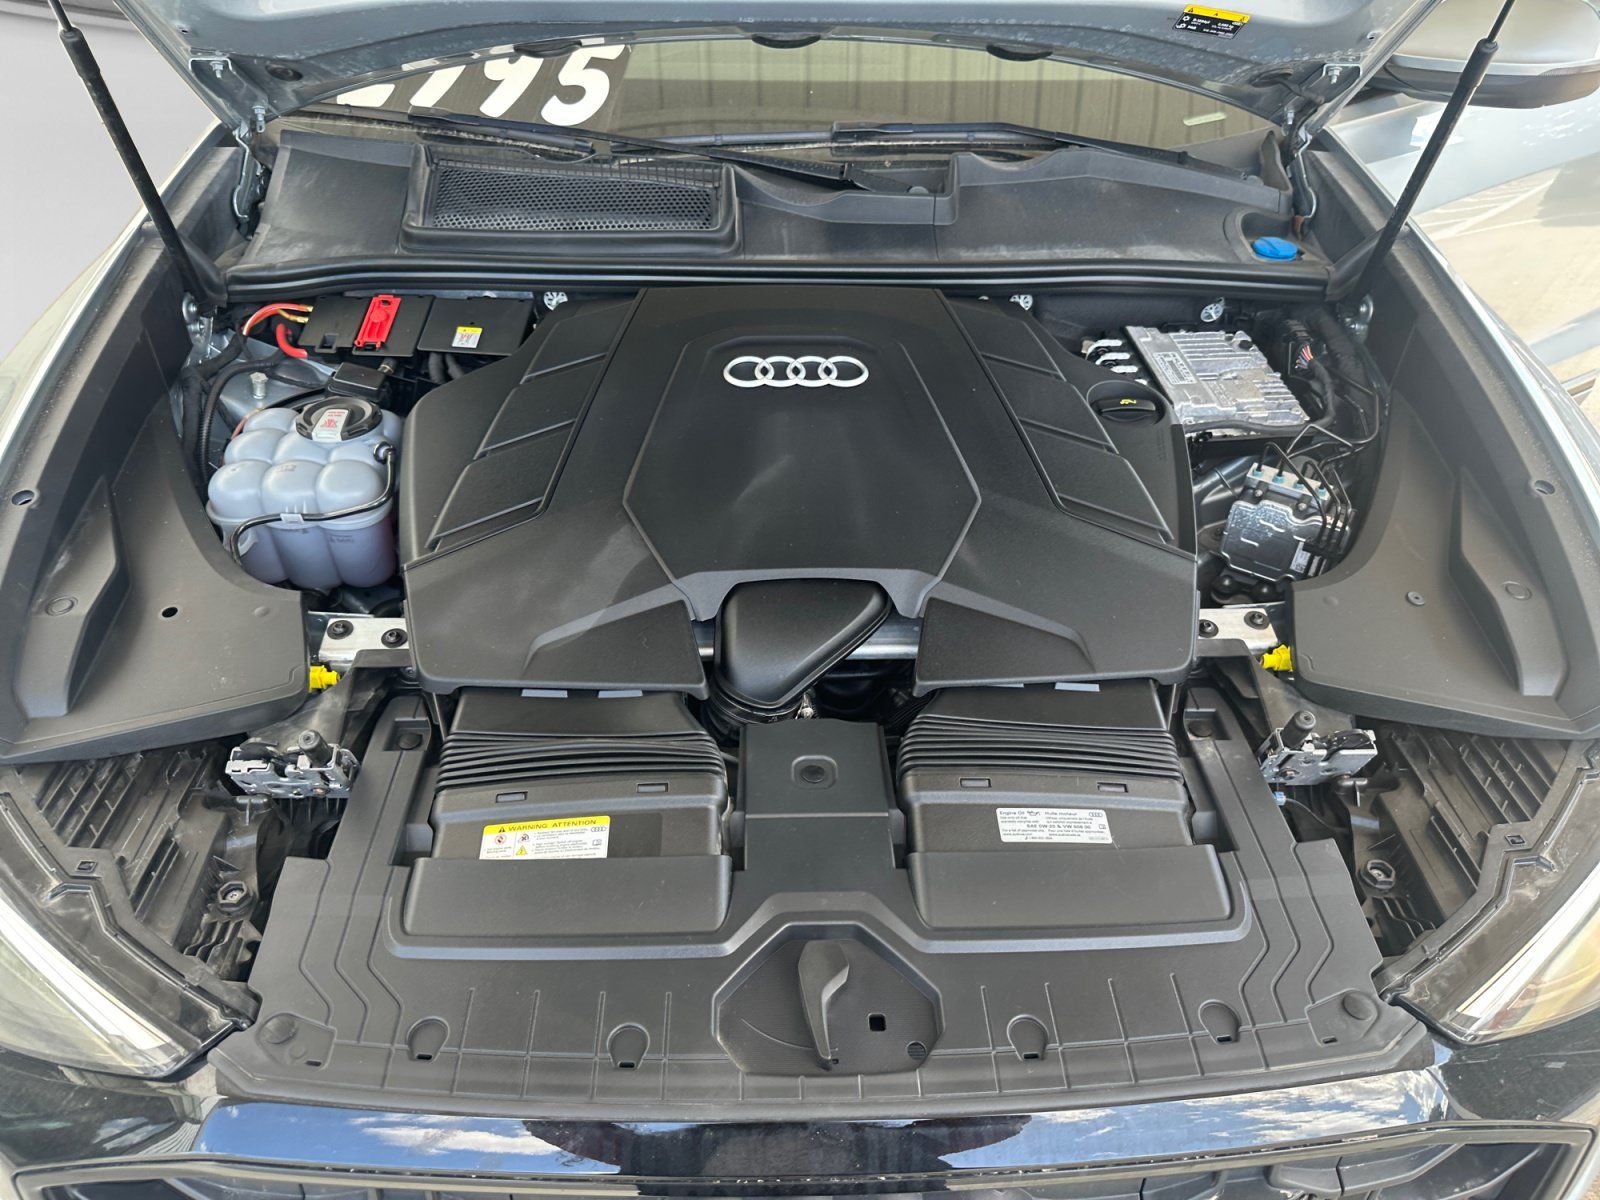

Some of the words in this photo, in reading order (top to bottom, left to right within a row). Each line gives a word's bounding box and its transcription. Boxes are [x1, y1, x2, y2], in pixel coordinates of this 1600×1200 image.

[336, 43, 626, 126] 95
[508, 823, 548, 832] WARNING
[552, 819, 597, 828] ATTENTION
